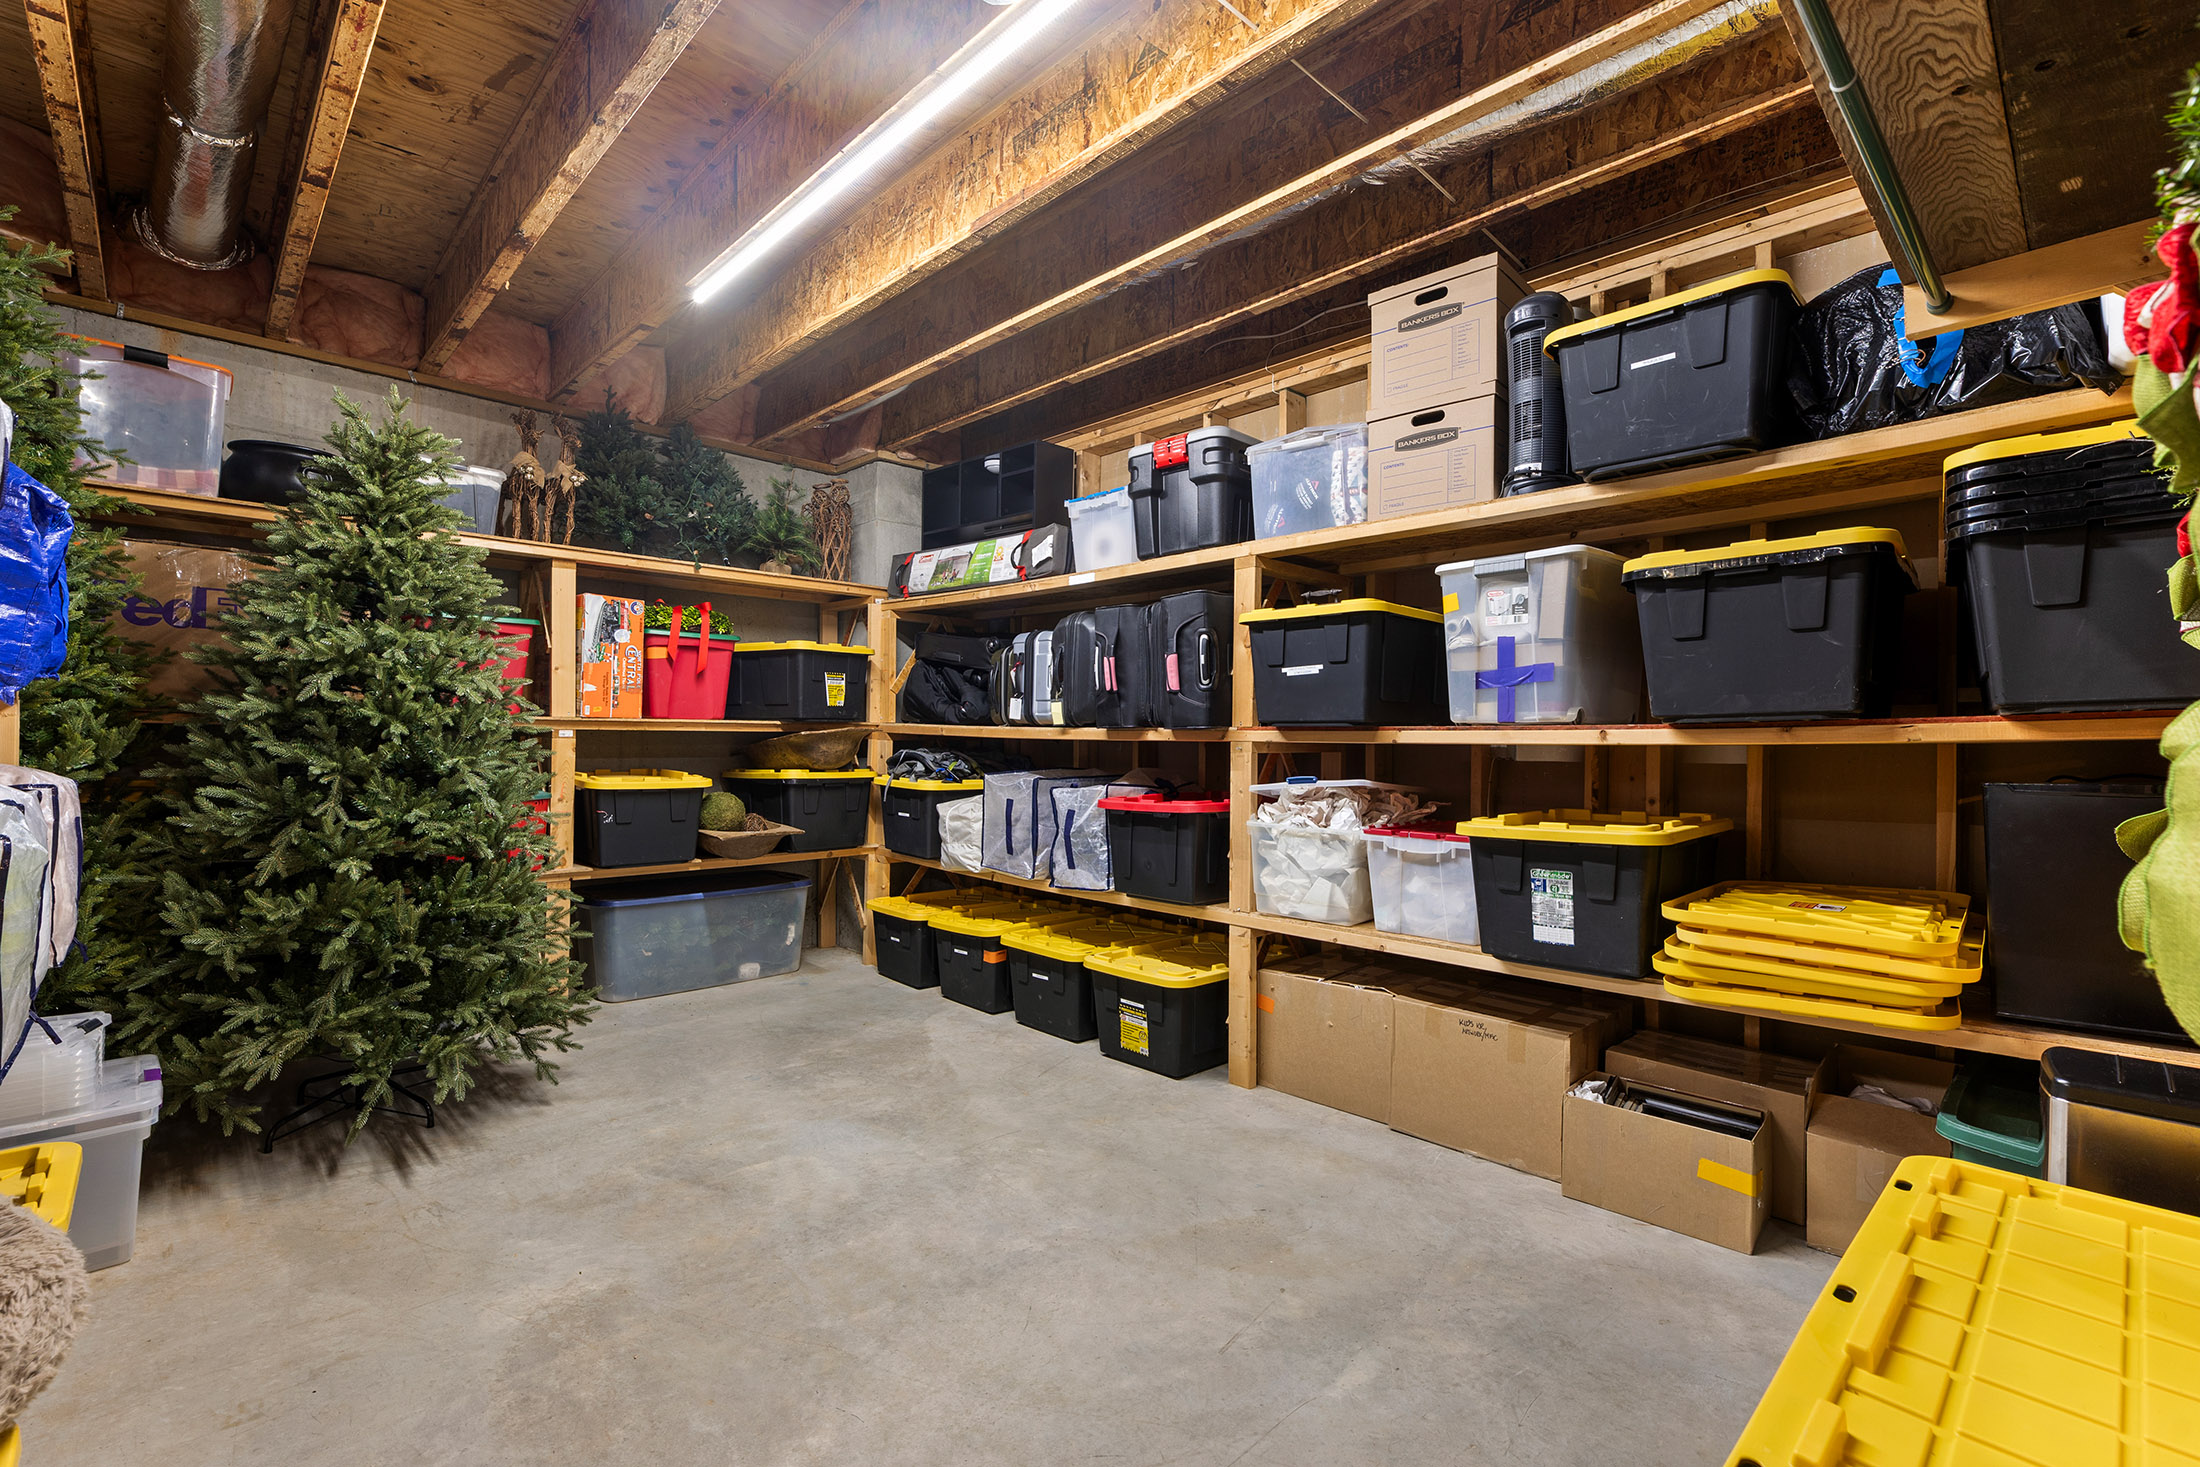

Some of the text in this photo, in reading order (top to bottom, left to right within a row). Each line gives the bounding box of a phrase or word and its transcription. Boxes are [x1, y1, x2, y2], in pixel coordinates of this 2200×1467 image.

[1401, 306, 1460, 329] BANKERS BOX
[1398, 430, 1455, 448] BANKERS BOX
[625, 644, 639, 692] CENTRAL
